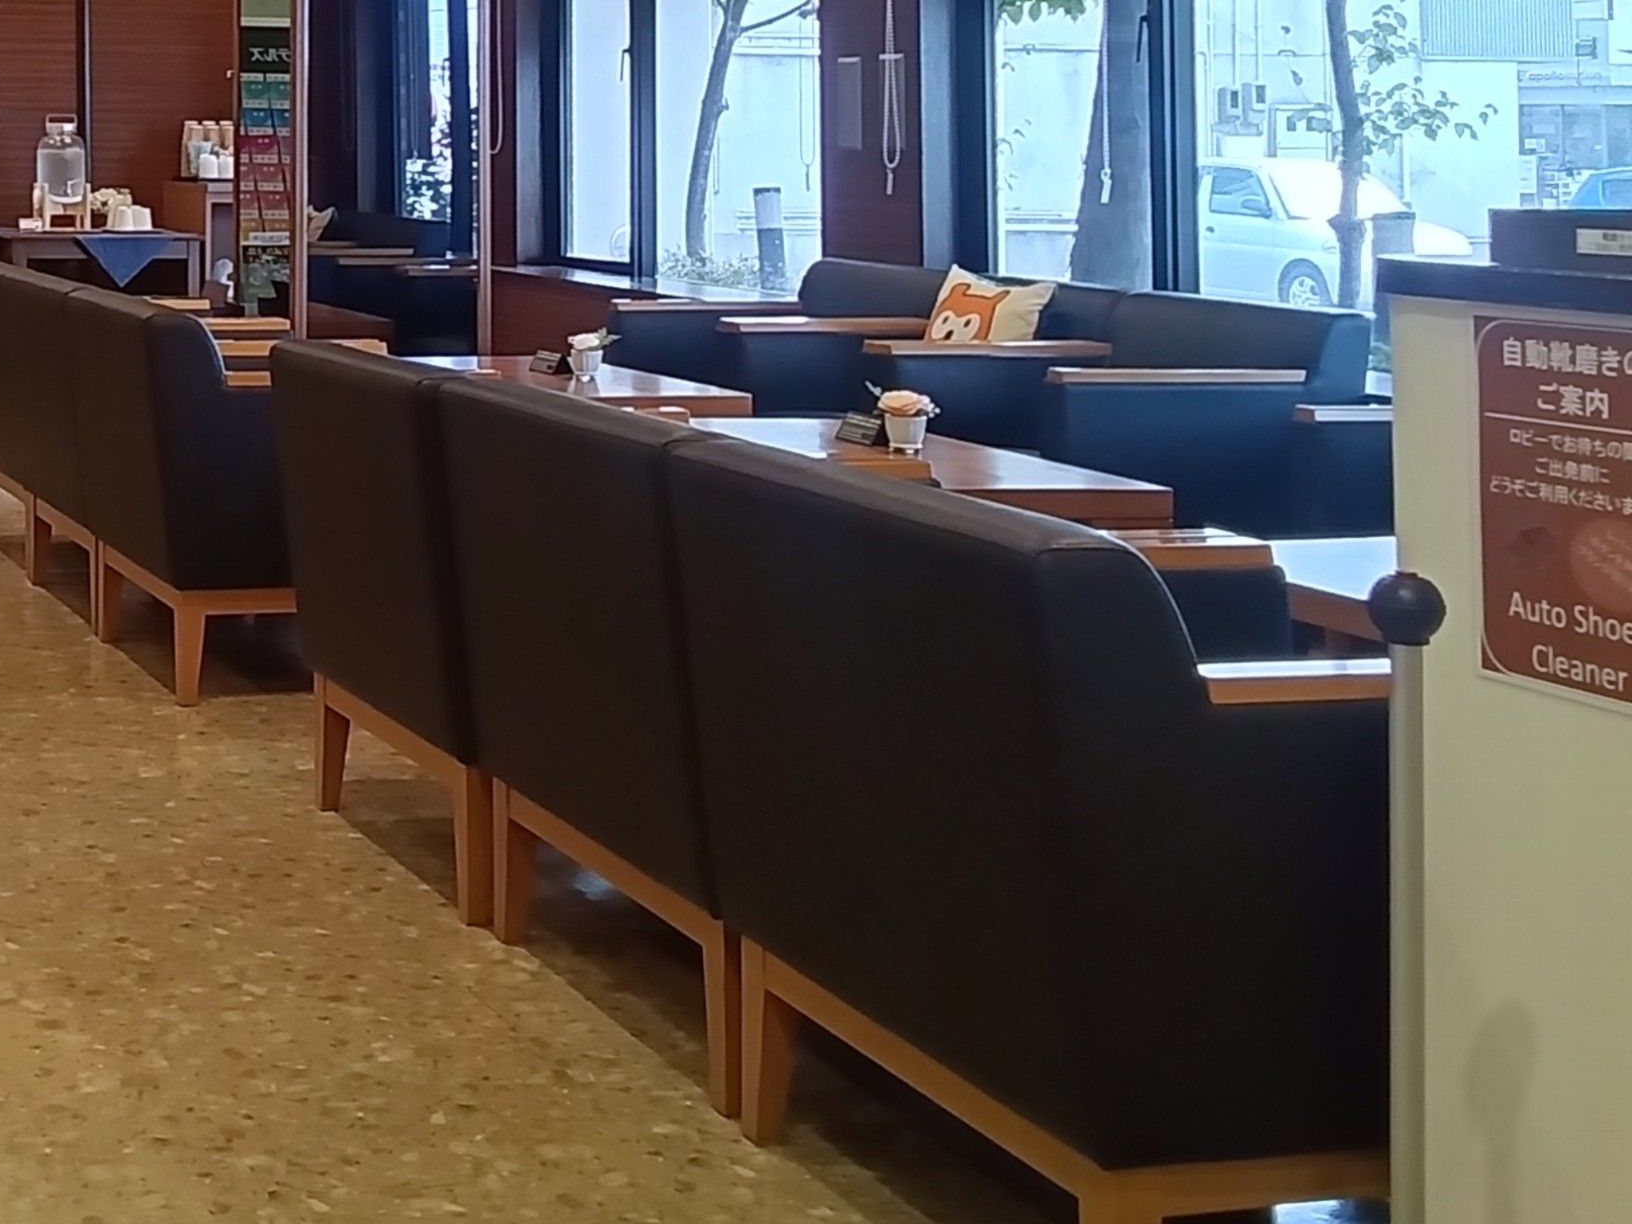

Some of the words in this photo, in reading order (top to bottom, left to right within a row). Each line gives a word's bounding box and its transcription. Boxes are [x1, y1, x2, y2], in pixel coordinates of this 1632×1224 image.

[1537, 382, 1609, 419] ご案内
[1535, 457, 1610, 483] ご出発前に
[1509, 591, 1567, 628] Auto
[1574, 605, 1632, 645] Shoe
[1532, 644, 1629, 692] Cleaner
